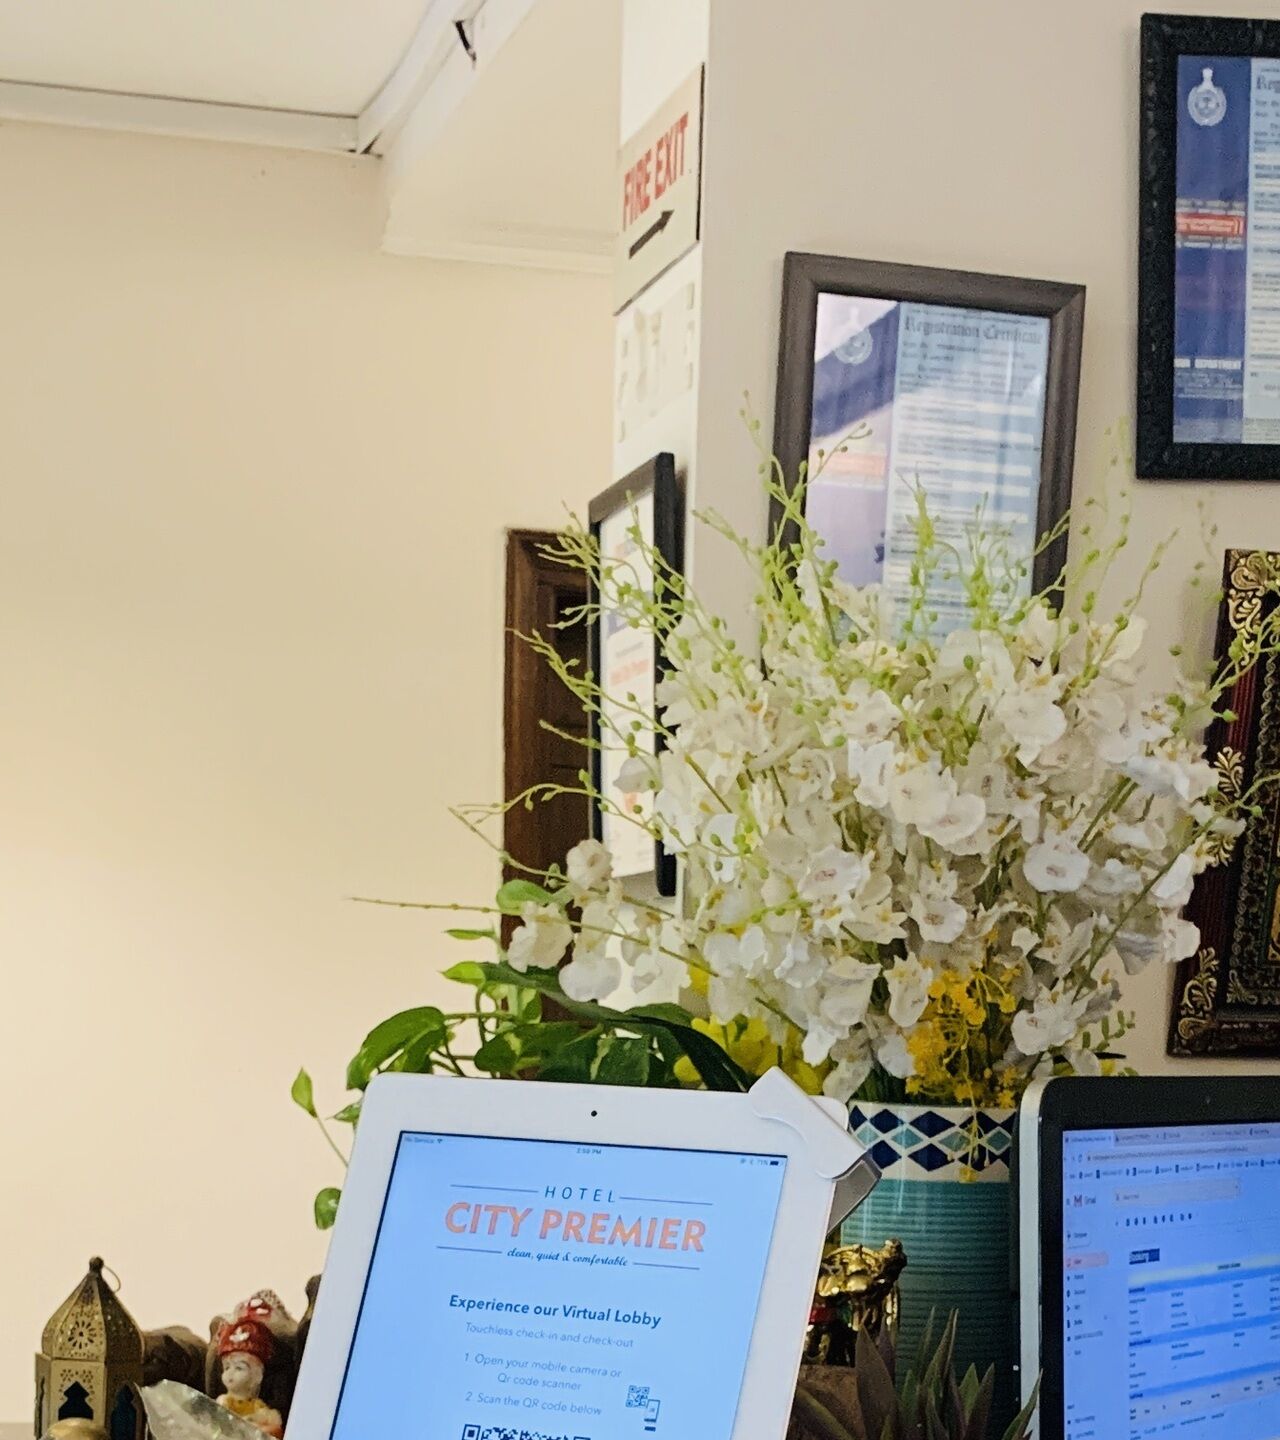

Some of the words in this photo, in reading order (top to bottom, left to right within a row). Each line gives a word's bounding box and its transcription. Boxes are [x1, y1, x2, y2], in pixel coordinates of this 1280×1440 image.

[622, 148, 651, 232] FIRE
[654, 111, 689, 200] EXIT
[544, 1186, 616, 1203] HOTEL
[444, 1202, 533, 1237] CITY
[538, 1209, 707, 1252] PREMIER
[507, 1247, 534, 1260] clean,
[536, 1250, 561, 1263] quiet
[562, 1252, 570, 1262] &
[572, 1253, 629, 1268] comfortable
[449, 1294, 530, 1314] Experience
[533, 1305, 559, 1318] our
[563, 1305, 611, 1321] Virtual
[614, 1310, 662, 1329] Lobby
[465, 1322, 513, 1337] Touchless
[515, 1327, 558, 1341] check-in
[560, 1332, 580, 1343] and
[582, 1334, 634, 1348] check-out
[474, 1353, 504, 1367] Open
[505, 1358, 529, 1369] your
[531, 1358, 567, 1373] mobile
[569, 1366, 608, 1377] camera
[610, 1369, 622, 1378] or
[497, 1373, 511, 1384] Qr
[513, 1375, 539, 1387] code
[541, 1379, 582, 1391] scanner
[477, 1393, 502, 1405] Scan
[504, 1395, 520, 1406] the
[522, 1397, 539, 1409] QR
[541, 1400, 567, 1412] code
[570, 1403, 602, 1415] below
